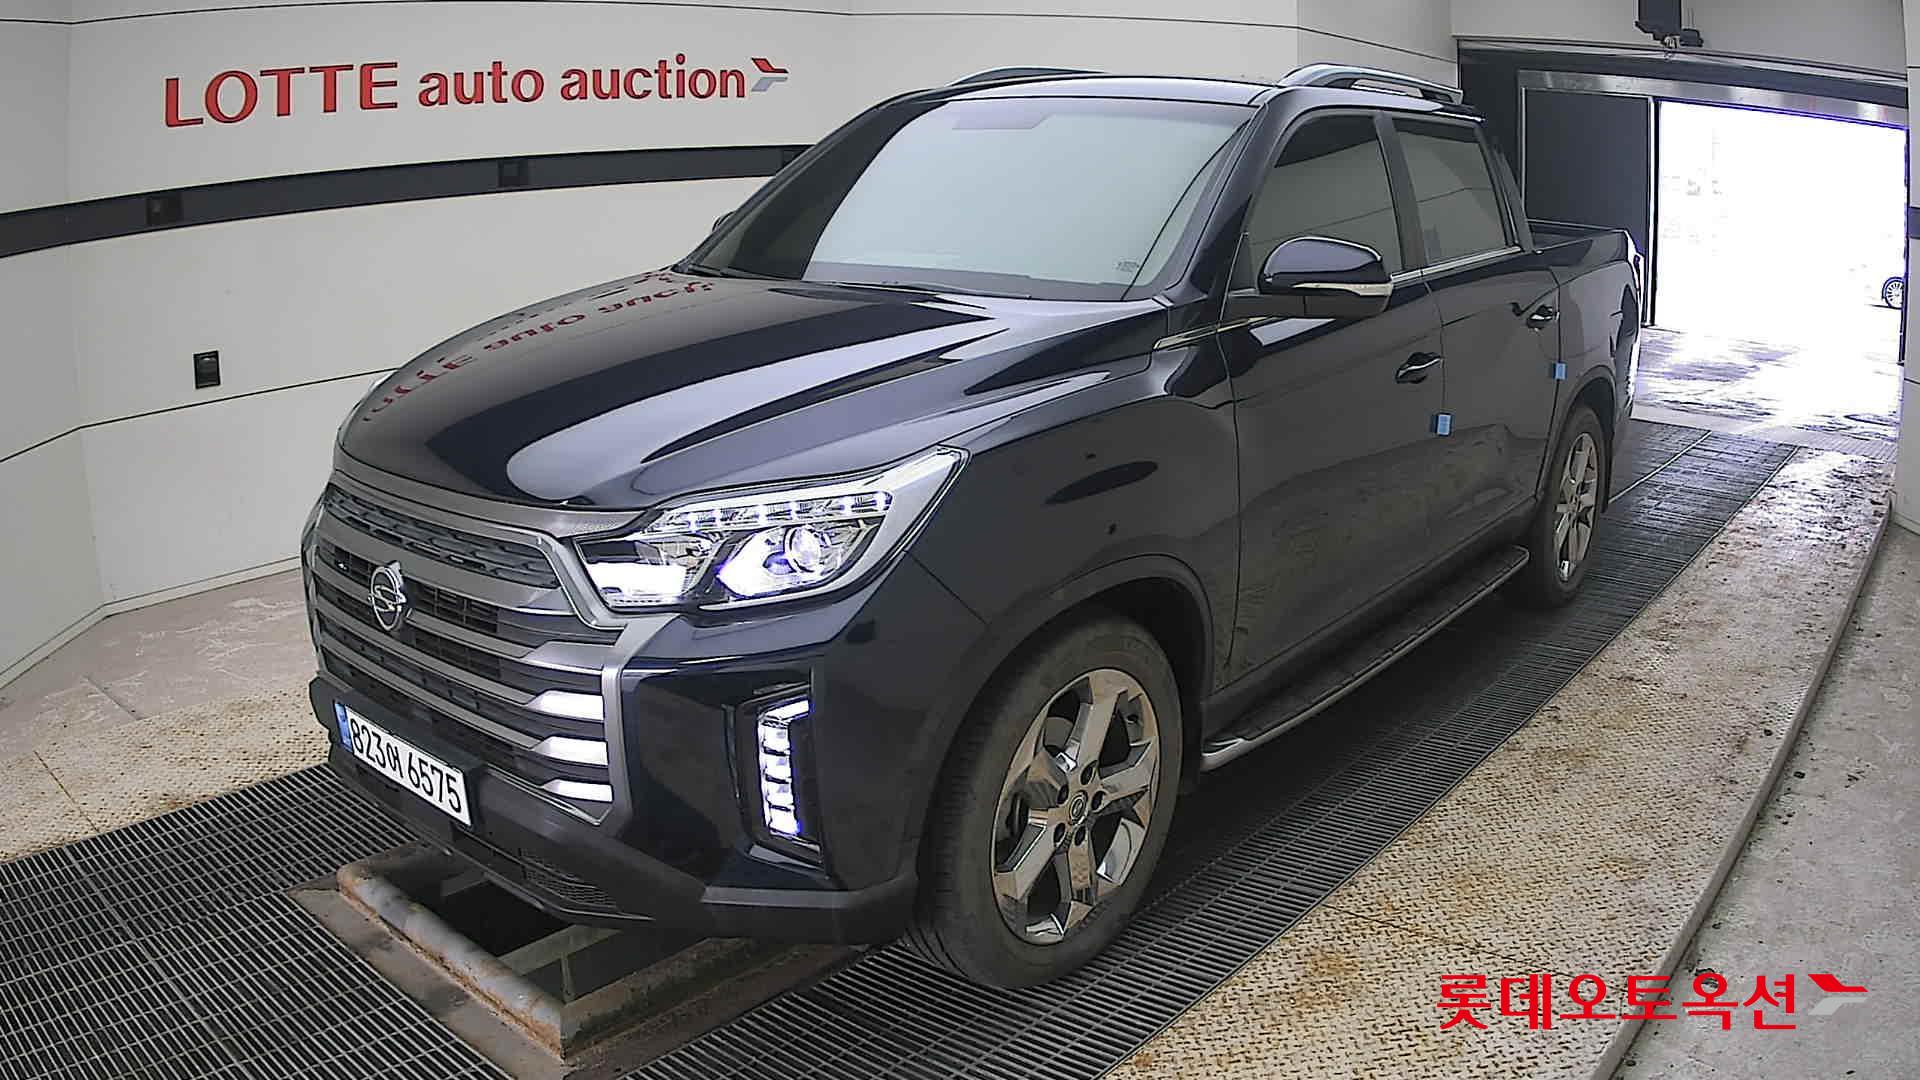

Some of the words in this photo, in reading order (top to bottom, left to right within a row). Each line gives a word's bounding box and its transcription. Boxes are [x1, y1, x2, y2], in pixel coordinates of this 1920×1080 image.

[164, 61, 398, 128] LOTTE
[417, 61, 545, 107] auto
[559, 53, 746, 101] auction
[350, 718, 404, 779] 823어
[407, 751, 462, 813] 6575
